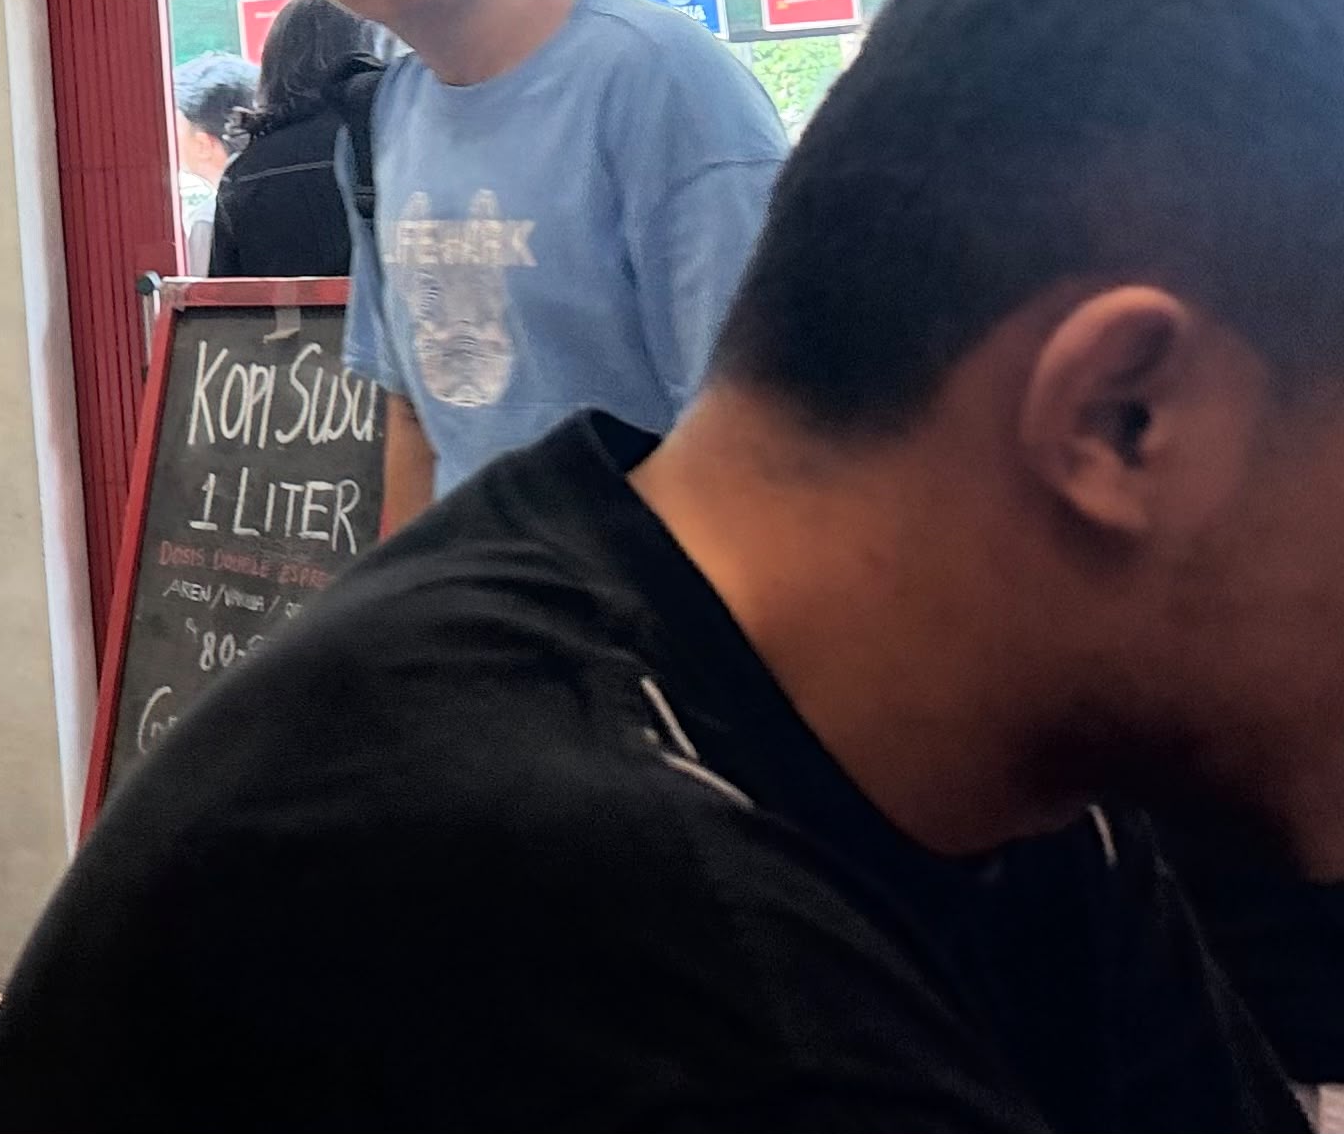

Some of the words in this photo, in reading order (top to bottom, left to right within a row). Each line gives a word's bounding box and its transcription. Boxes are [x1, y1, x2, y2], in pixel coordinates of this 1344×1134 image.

[187, 340, 277, 450] KOPI
[275, 342, 378, 447] SUSU
[188, 472, 219, 531] 1
[231, 466, 361, 556] LITER
